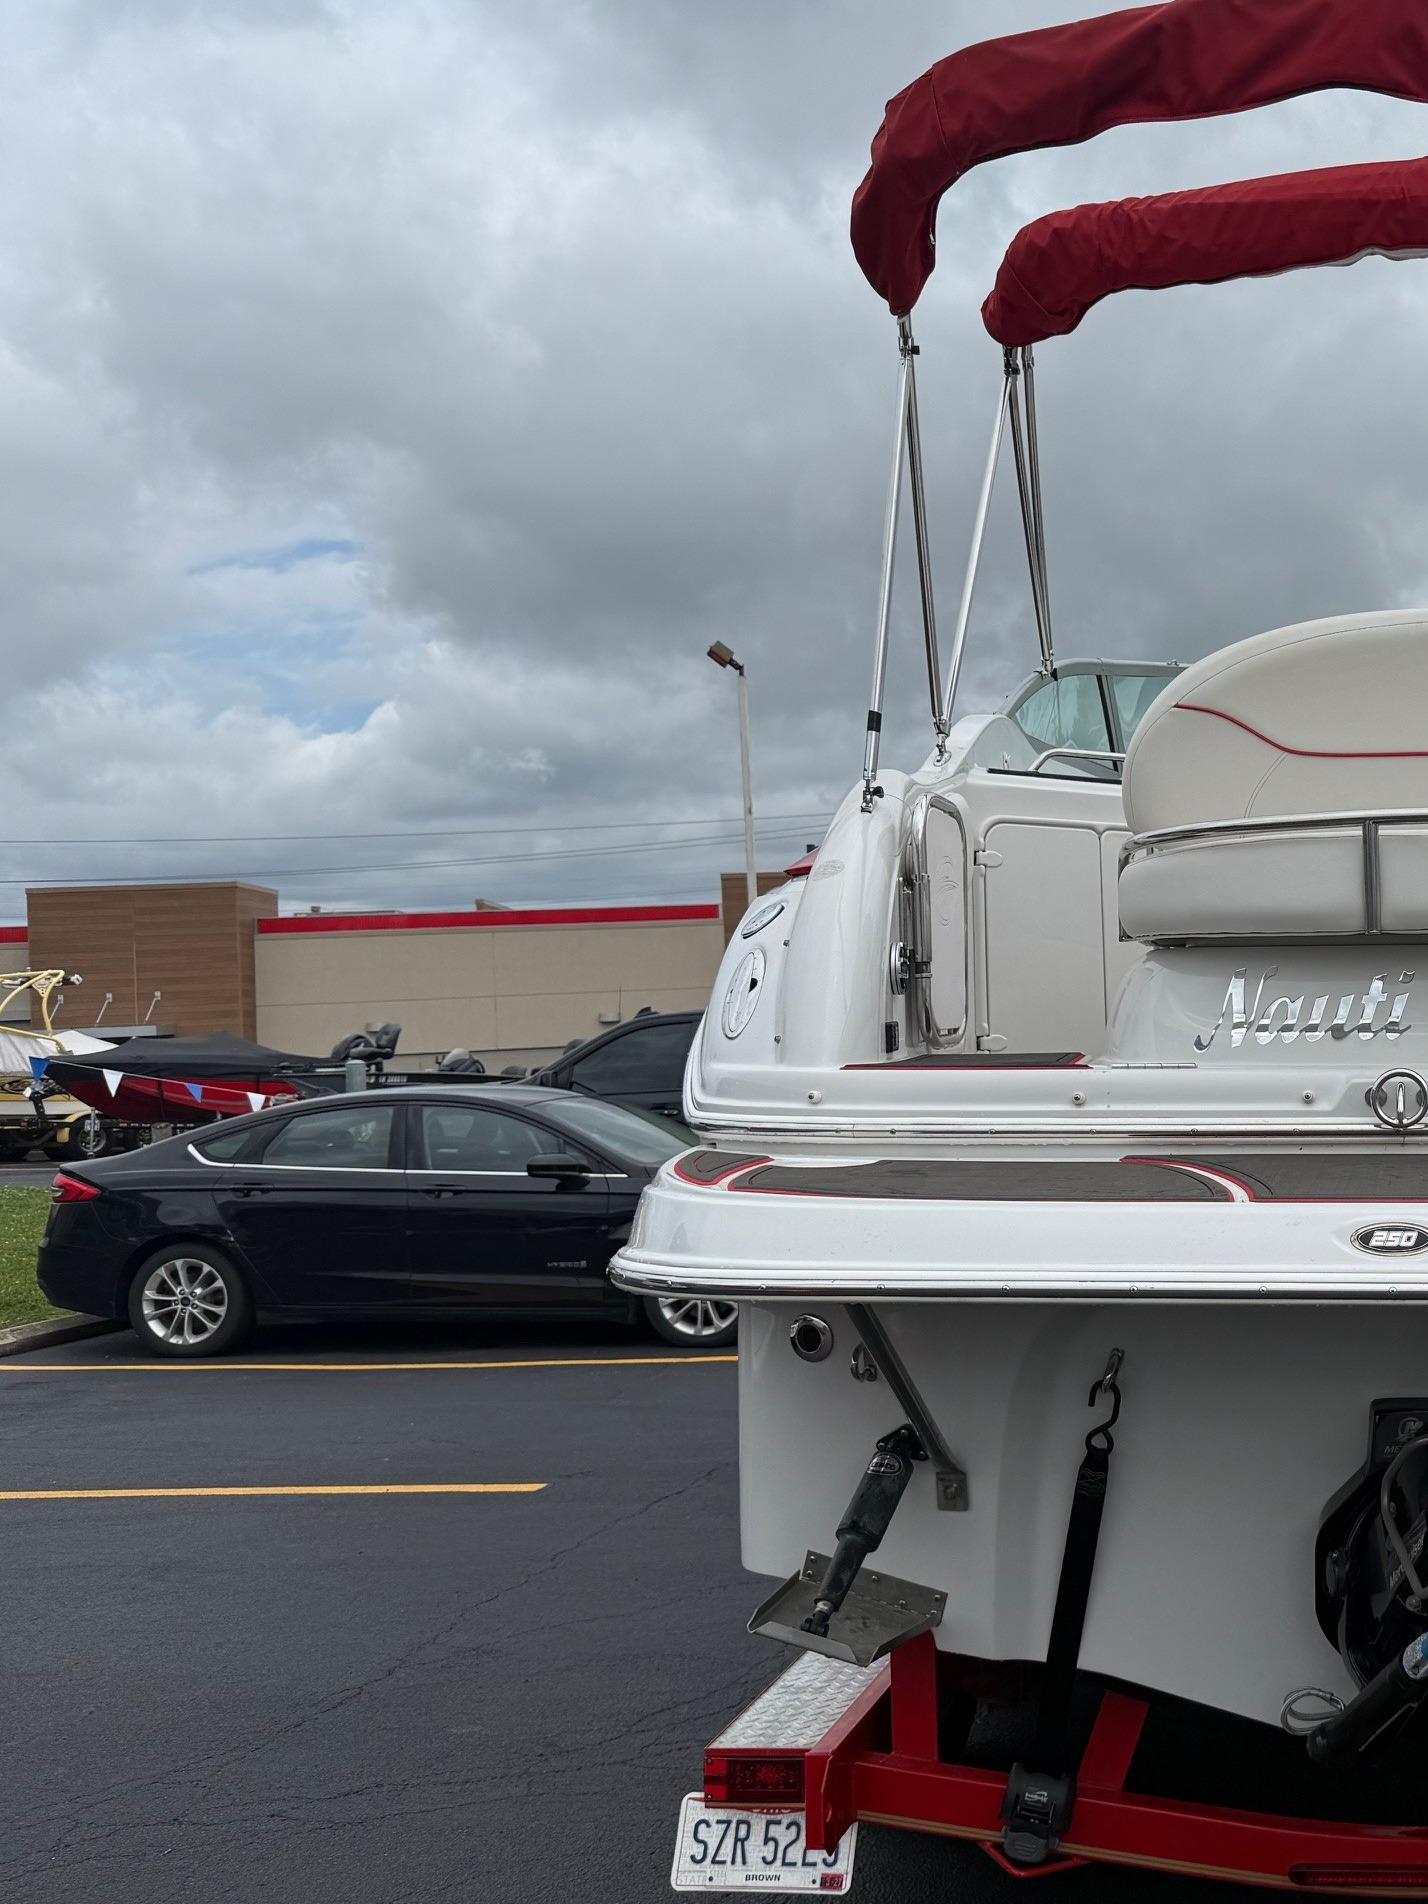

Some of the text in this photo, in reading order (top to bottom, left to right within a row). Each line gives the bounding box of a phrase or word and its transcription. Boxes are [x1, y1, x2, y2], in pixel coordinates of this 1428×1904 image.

[1193, 966, 1415, 1053] Nauti
[1368, 1230, 1419, 1247] 250
[690, 1819, 752, 1865] SZR
[744, 1873, 781, 1882] BROWN
